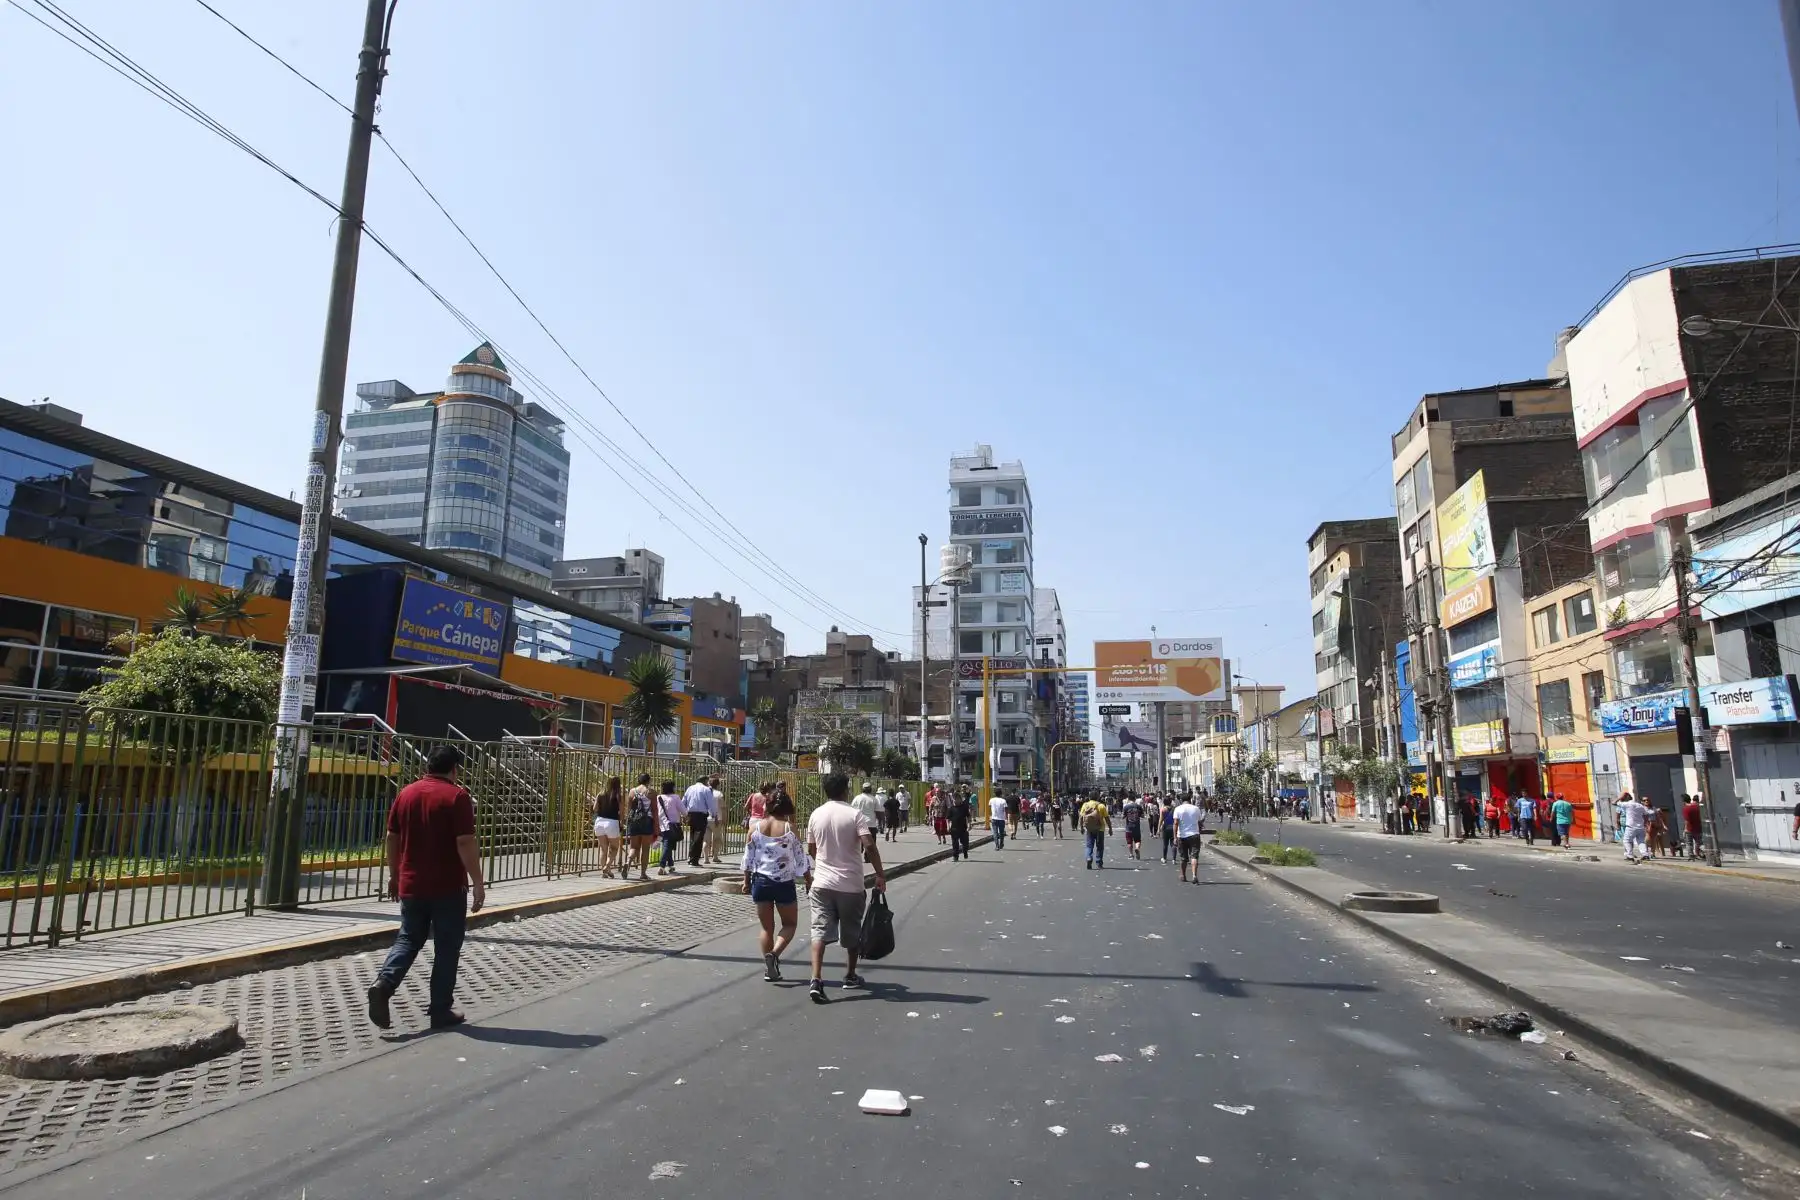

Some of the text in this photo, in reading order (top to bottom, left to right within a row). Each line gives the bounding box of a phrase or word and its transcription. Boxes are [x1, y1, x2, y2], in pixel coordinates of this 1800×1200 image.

[401, 619, 440, 639] Parque
[441, 623, 499, 655] Cánepa
[1173, 642, 1213, 652] Dardos
[1710, 687, 1753, 706] Transfer
[1631, 706, 1654, 722] Tony
[1726, 704, 1760, 716] Planchas
